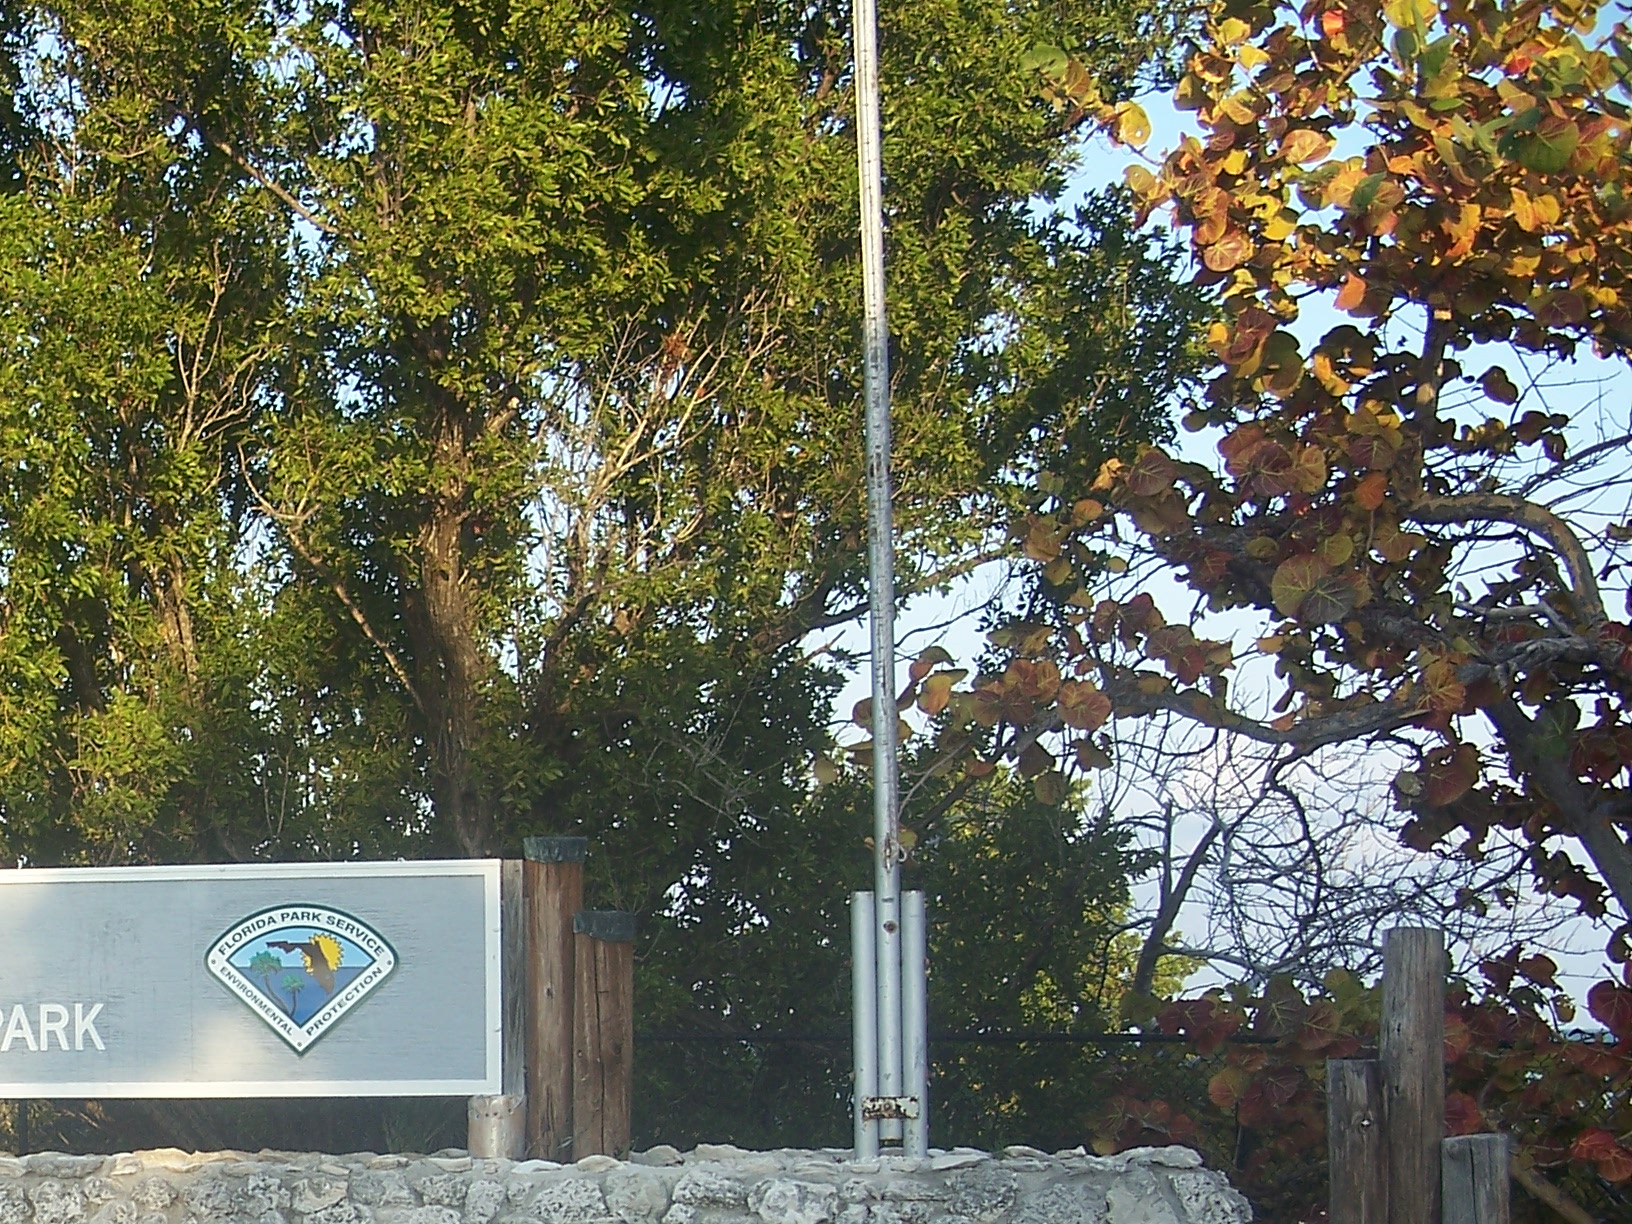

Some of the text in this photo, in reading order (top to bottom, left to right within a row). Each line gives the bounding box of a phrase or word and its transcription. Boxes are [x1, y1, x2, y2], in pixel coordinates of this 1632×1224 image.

[219, 911, 384, 957] FLORIDA PARK SERVICE
[220, 966, 293, 1036] ENVIRONMENTAL
[306, 967, 382, 1036] PROTECTION
